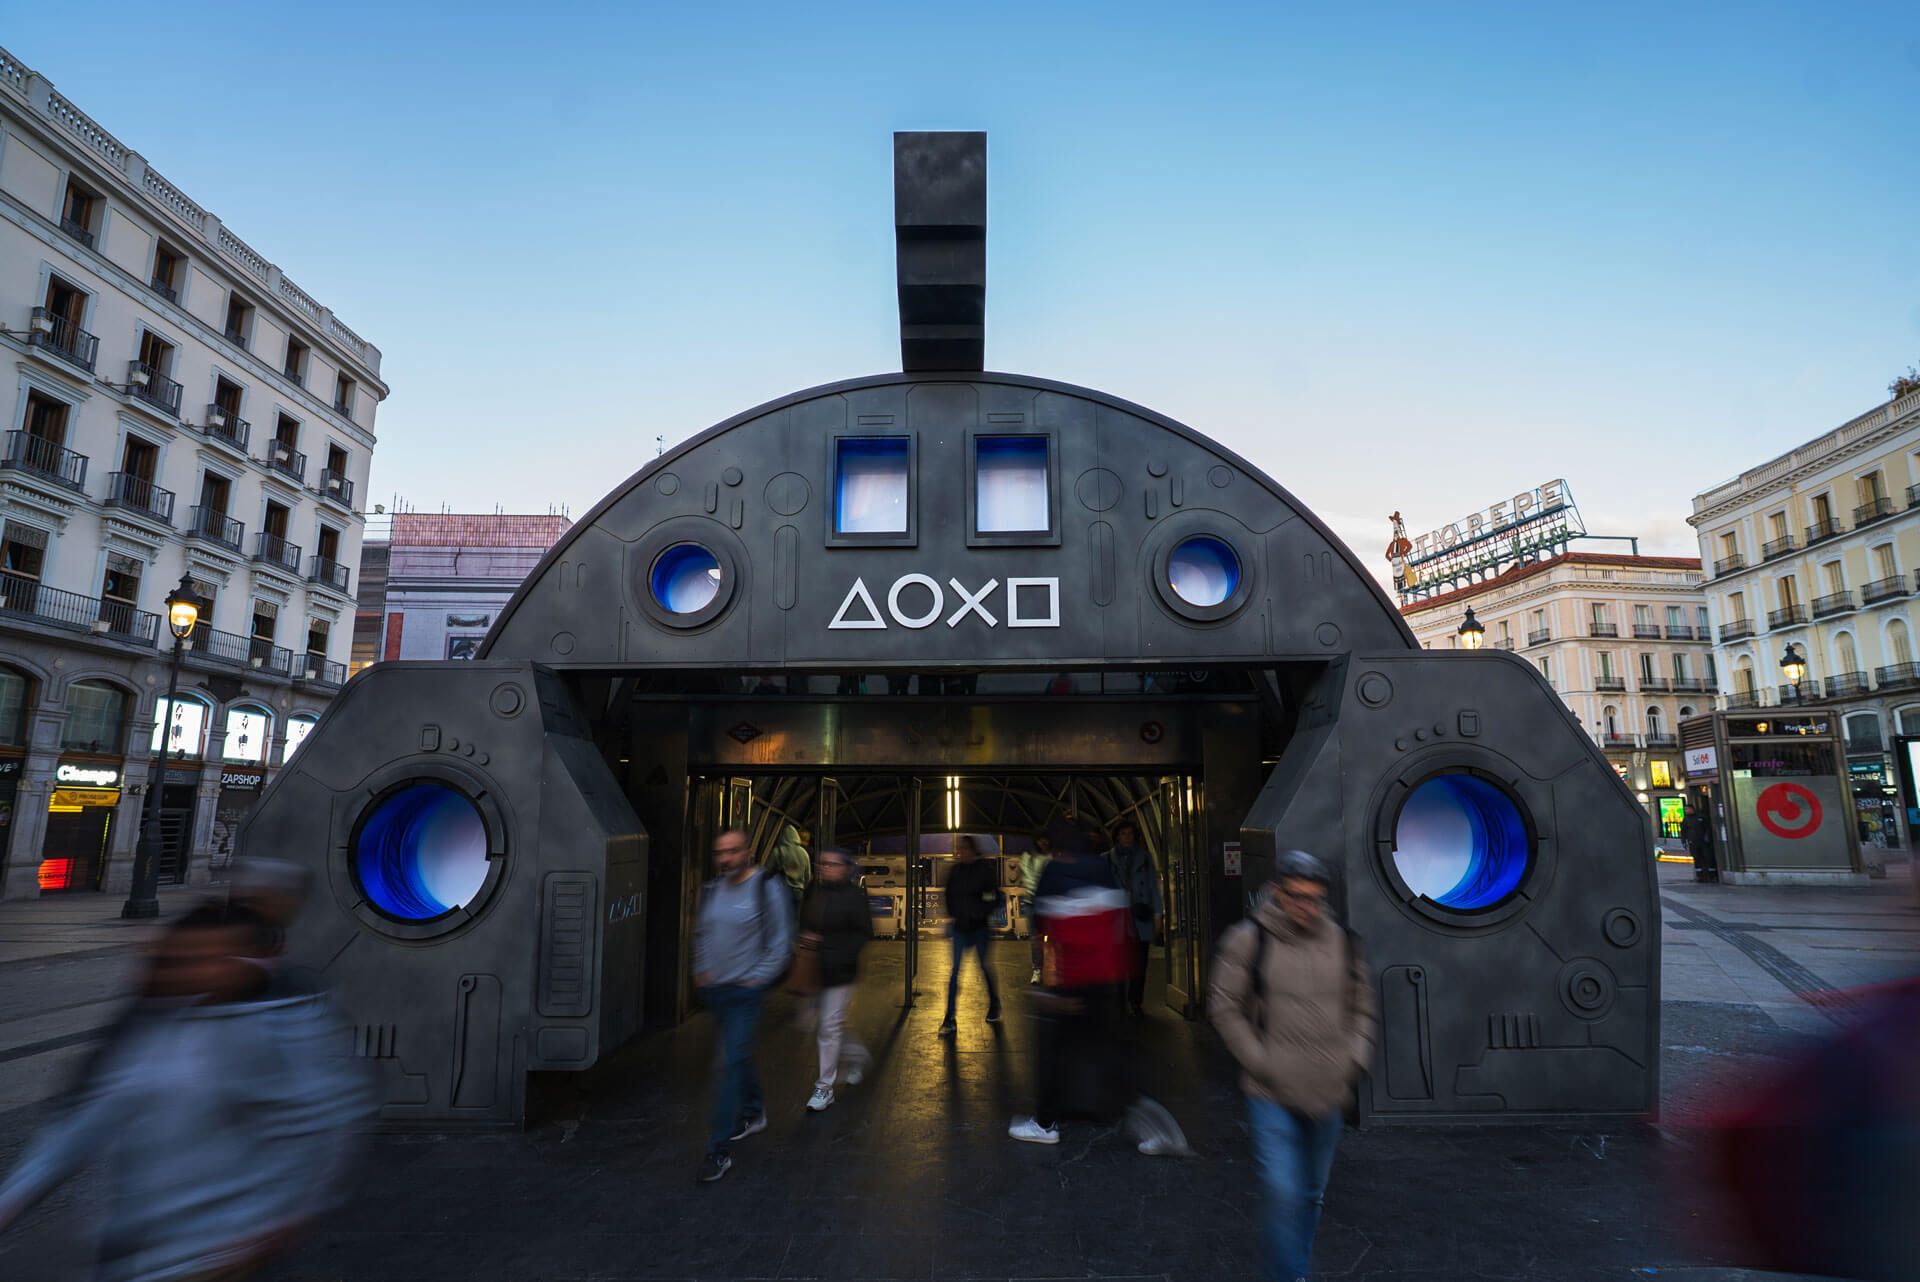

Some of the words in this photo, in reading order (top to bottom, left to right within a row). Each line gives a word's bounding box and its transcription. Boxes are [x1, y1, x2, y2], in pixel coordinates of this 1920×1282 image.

[1415, 524, 1457, 558] TIO
[1467, 479, 1563, 539] PEPE
[57, 765, 118, 786] Change
[221, 773, 261, 785] ZAPSHOP
